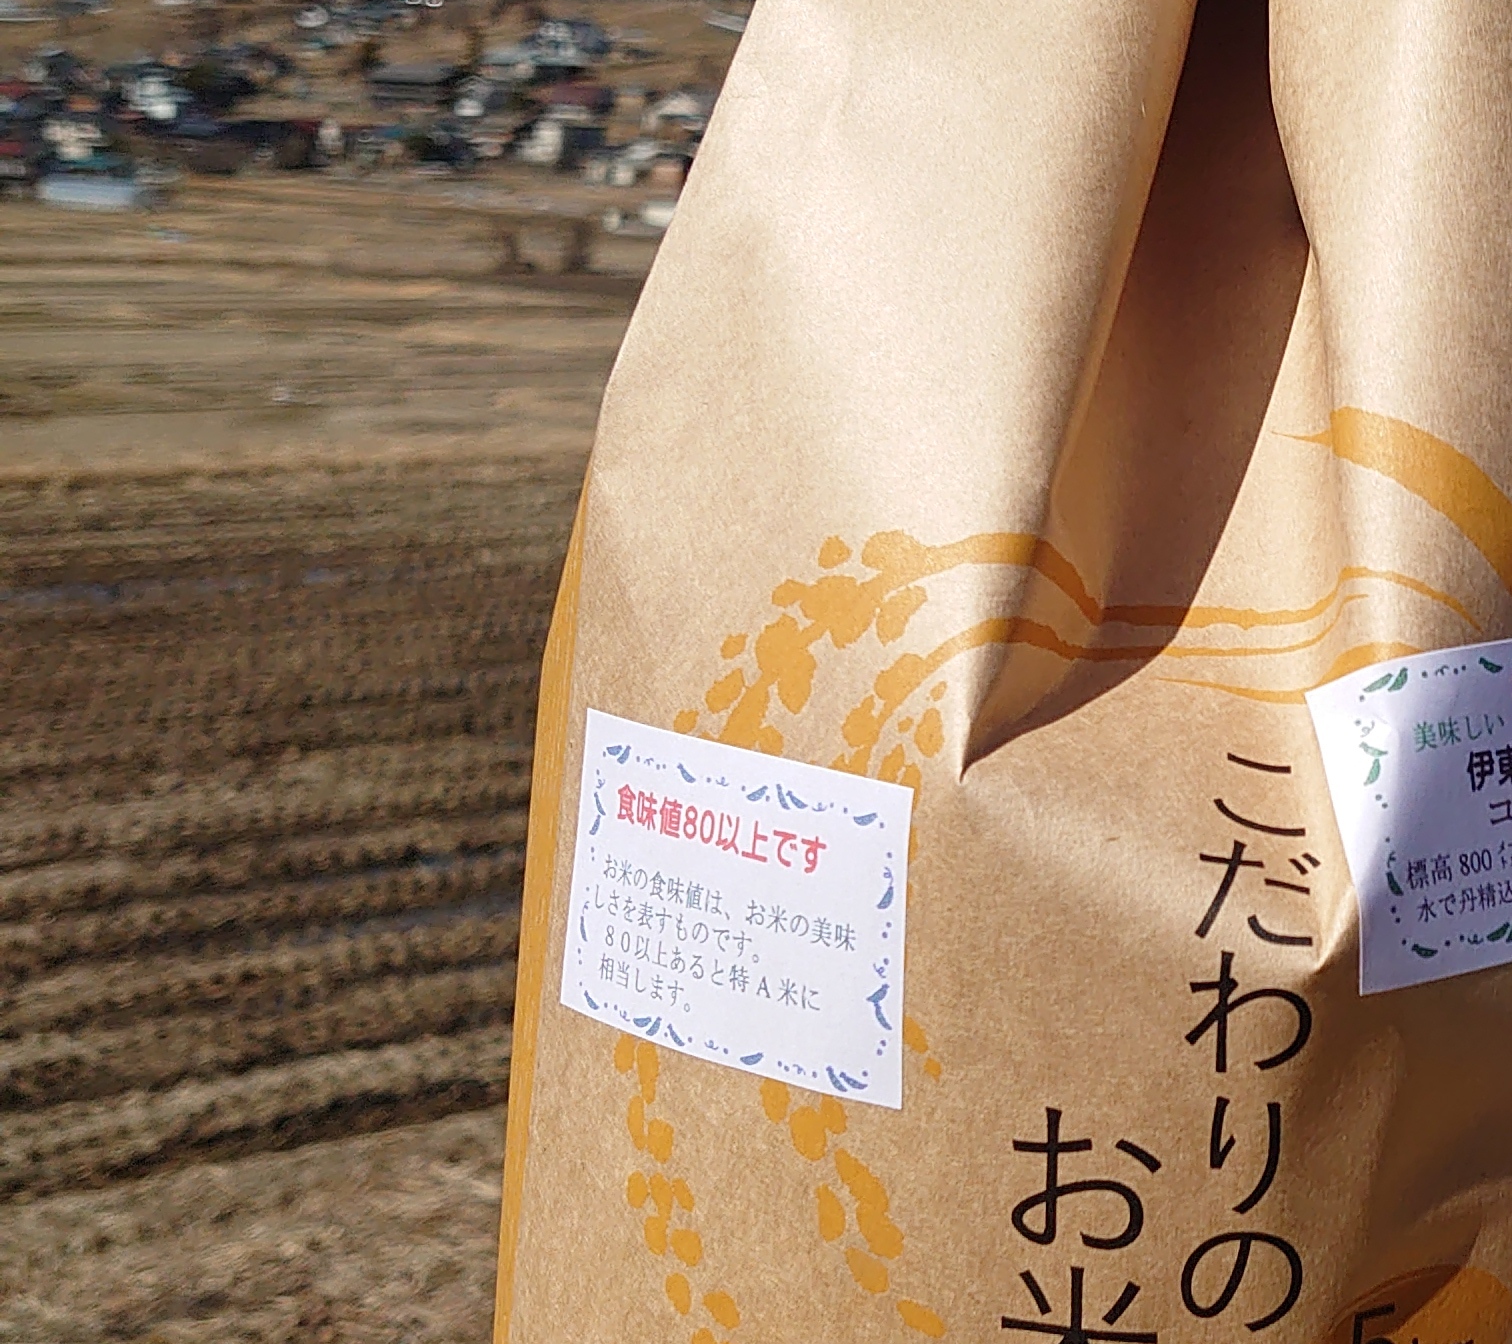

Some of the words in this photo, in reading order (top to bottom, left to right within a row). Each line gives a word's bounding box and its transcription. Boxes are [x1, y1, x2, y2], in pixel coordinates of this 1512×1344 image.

[1413, 714, 1505, 752] 美味しい
[617, 783, 827, 874] 食味値80以上です
[594, 886, 760, 964] しさを表すものです。
[603, 853, 856, 952] お米の食味値は、お米の美味
[598, 952, 692, 1014] 相当します。
[1179, 752, 1313, 1332] こだわりの
